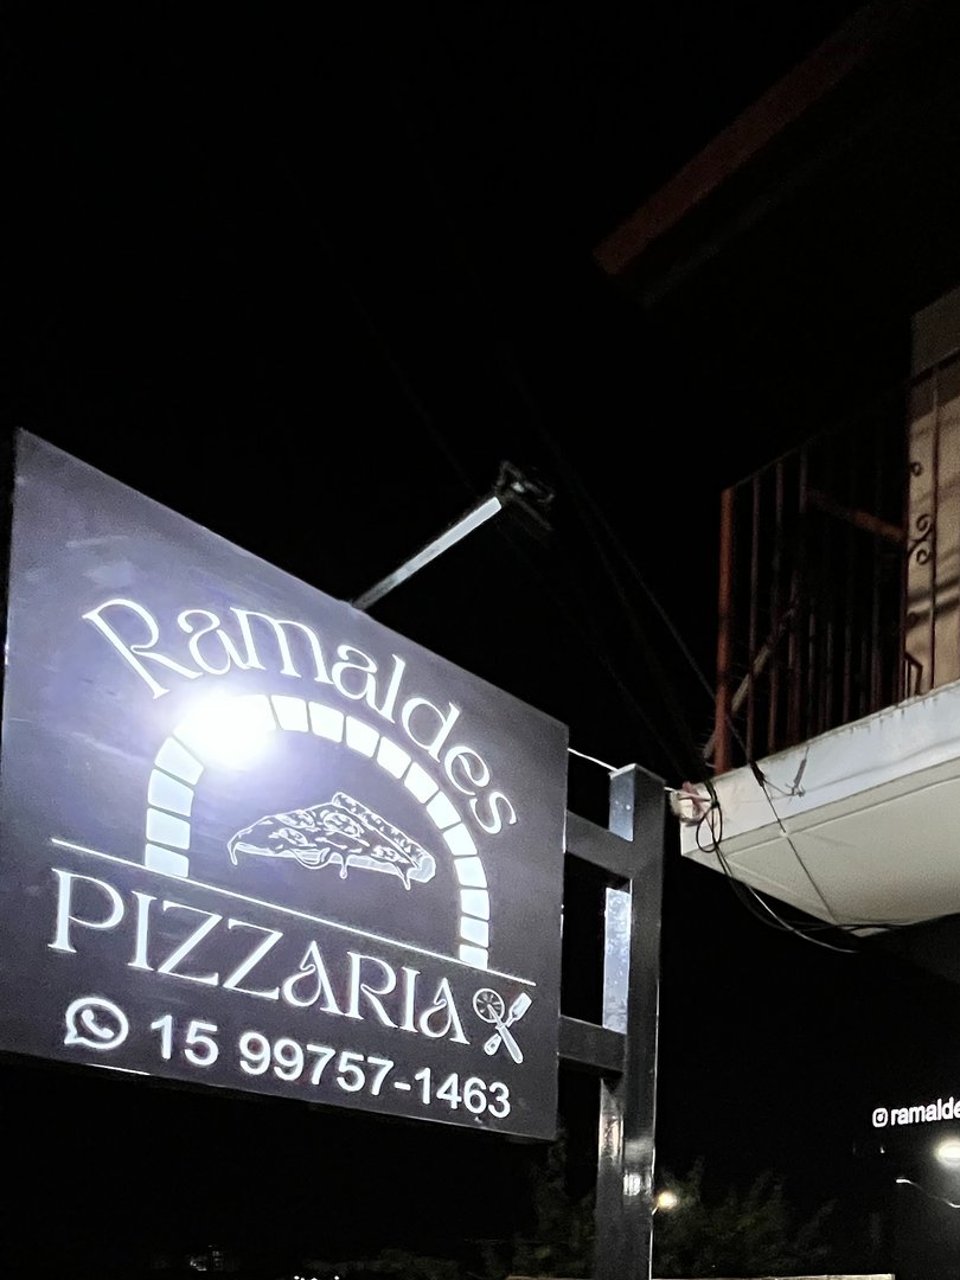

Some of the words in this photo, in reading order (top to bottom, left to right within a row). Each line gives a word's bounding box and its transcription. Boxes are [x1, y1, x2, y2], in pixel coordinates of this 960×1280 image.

[83, 598, 516, 835] Ramaldes
[48, 867, 471, 1046] PIZZARIA
[150, 1015, 219, 1066] 15
[240, 1032, 511, 1118] 99757-1463
